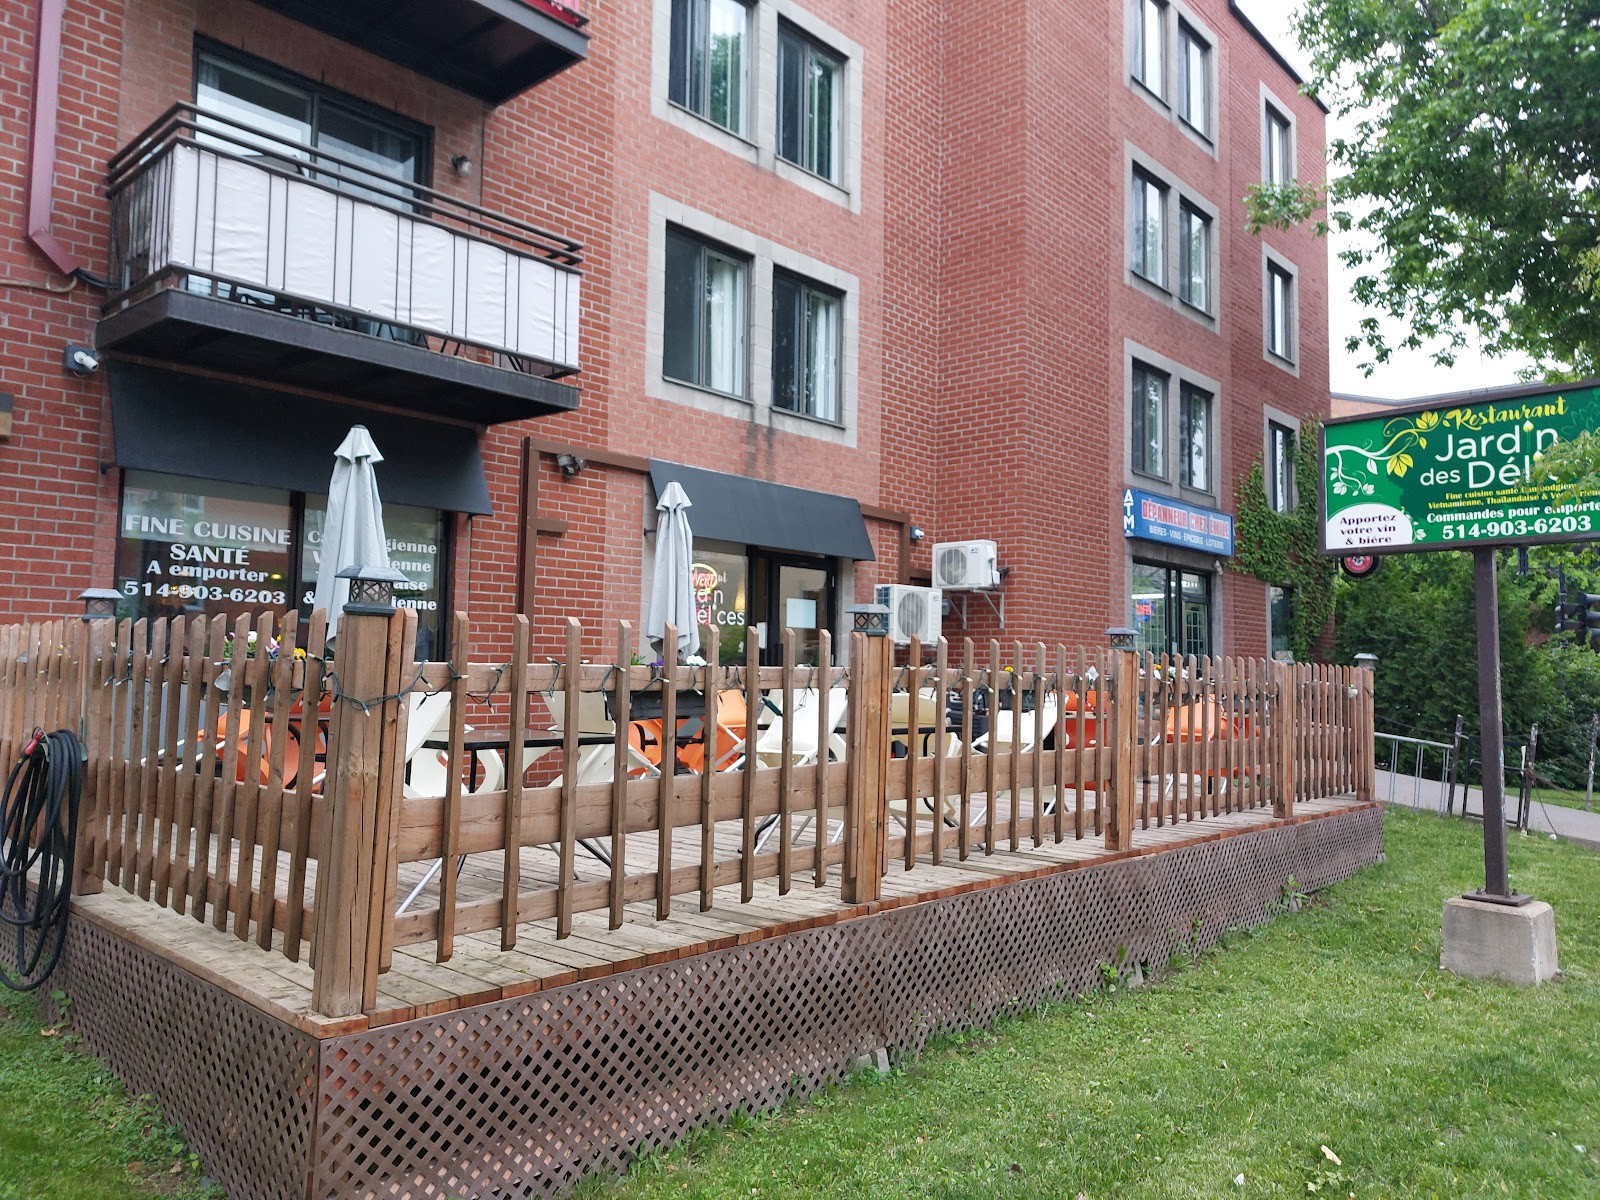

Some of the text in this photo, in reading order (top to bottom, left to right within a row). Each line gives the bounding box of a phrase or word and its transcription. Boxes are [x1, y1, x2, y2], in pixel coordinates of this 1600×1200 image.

[1445, 396, 1568, 431] Restaurant
[1420, 468, 1461, 486] des
[1446, 492, 1463, 500] Fine
[1465, 489, 1493, 499] cuisine
[1541, 492, 1548, 500] &
[1123, 489, 1135, 530] ATM
[1141, 498, 1188, 530] DÉPANNEUR
[1340, 514, 1397, 526] Apportez
[1427, 508, 1504, 524] Commandes
[1508, 506, 1541, 519] pour
[125, 514, 292, 546] FINE CUISINE
[1340, 524, 1396, 535] votre vin
[1442, 515, 1591, 540] 514-903-6203
[1345, 537, 1354, 546] &
[170, 544, 250, 566] SANTÉ
[146, 559, 269, 583] A emporter
[123, 580, 286, 605] 514-903-6203
